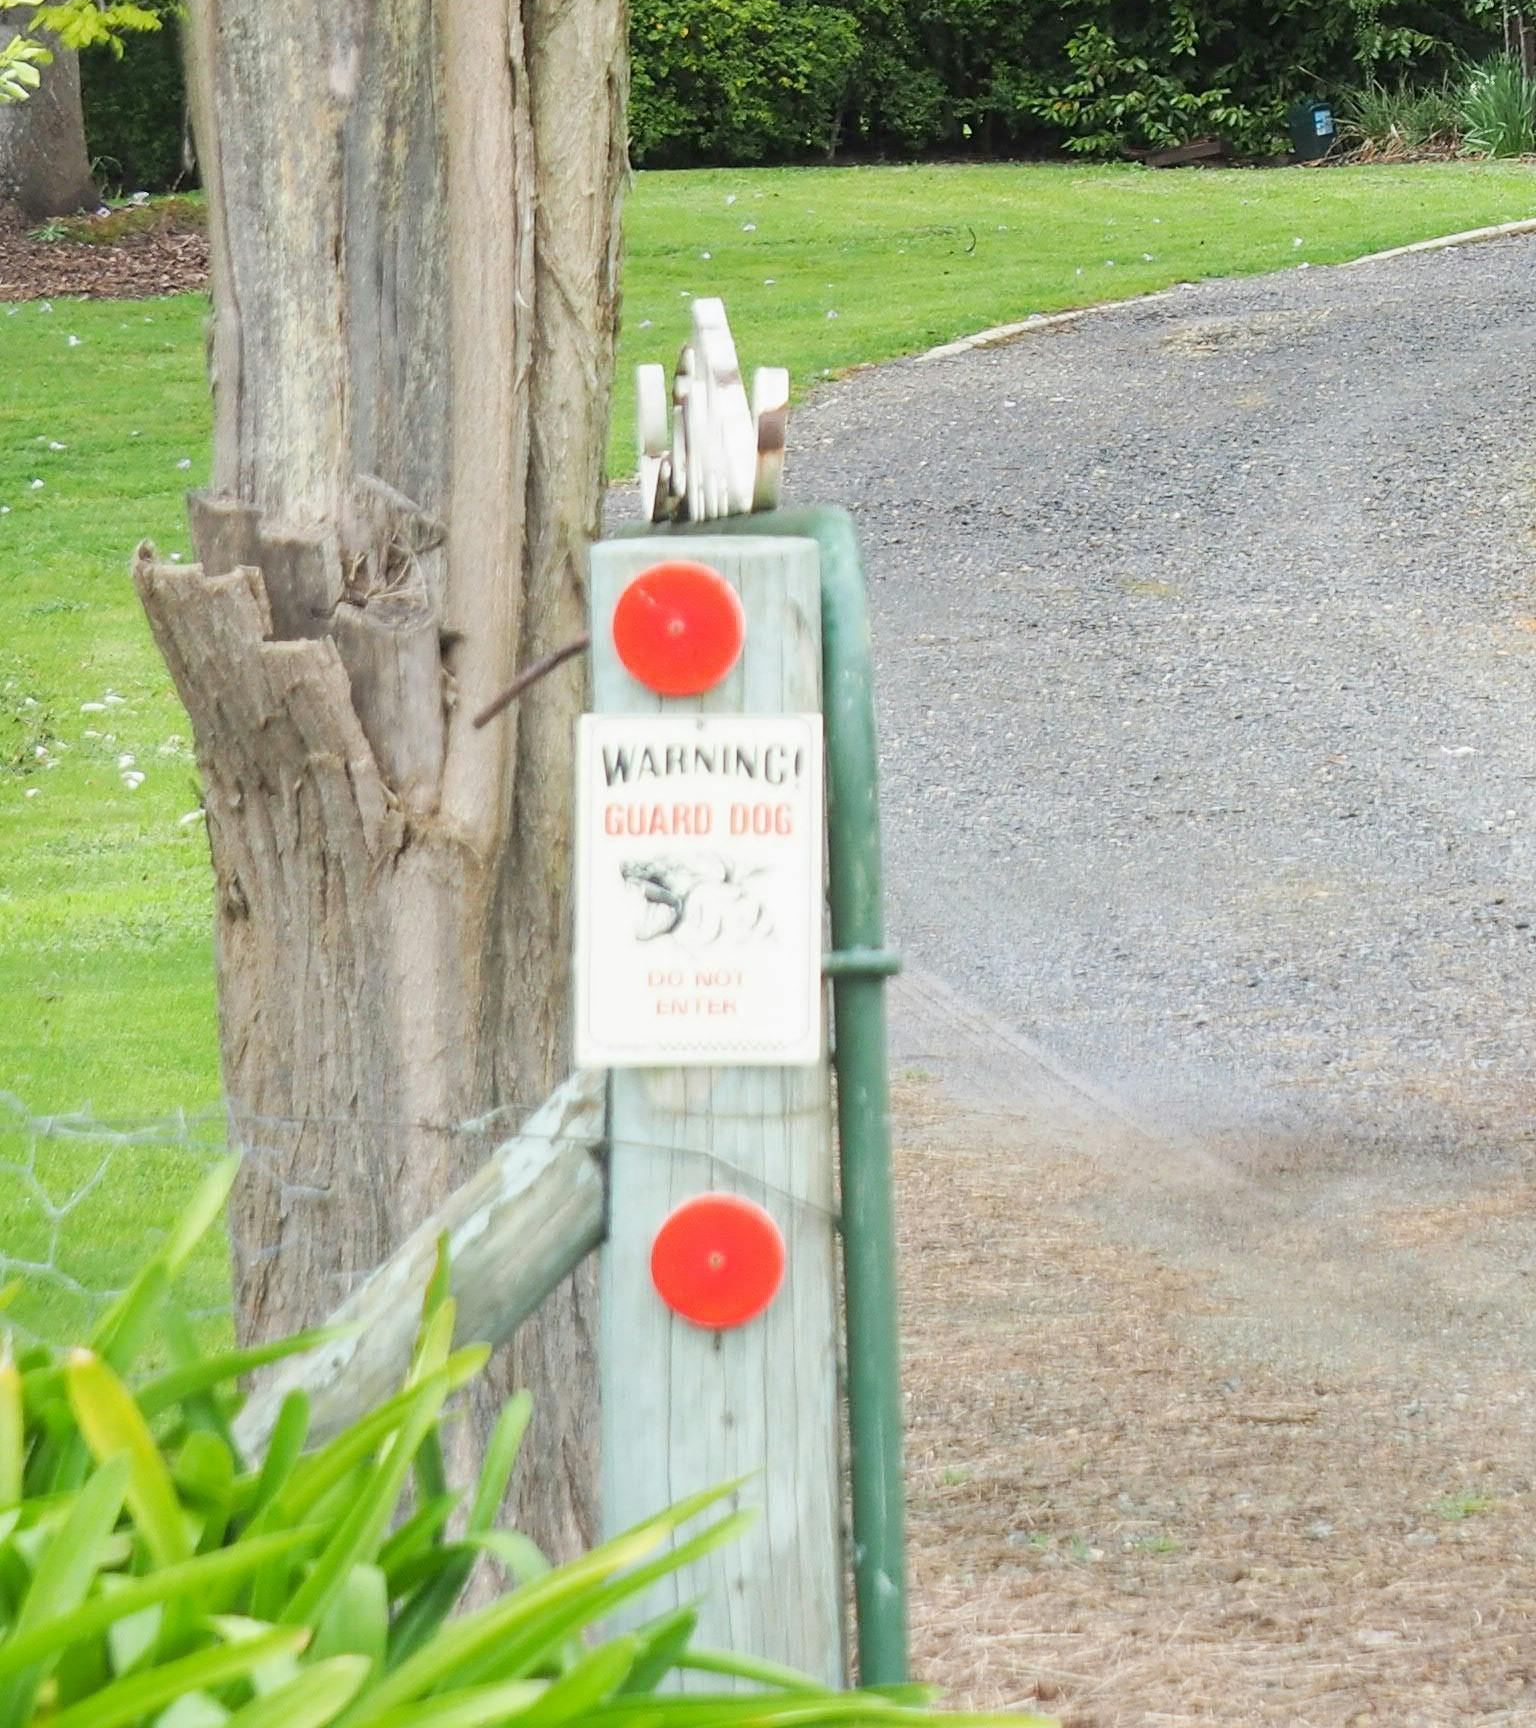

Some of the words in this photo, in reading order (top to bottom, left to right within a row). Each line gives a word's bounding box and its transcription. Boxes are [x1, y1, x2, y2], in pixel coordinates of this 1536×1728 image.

[604, 802, 713, 836] GUARD
[730, 802, 794, 836] DOG
[647, 970, 684, 987] DO
[696, 969, 744, 987] NOT
[656, 999, 737, 1016] ENTER
